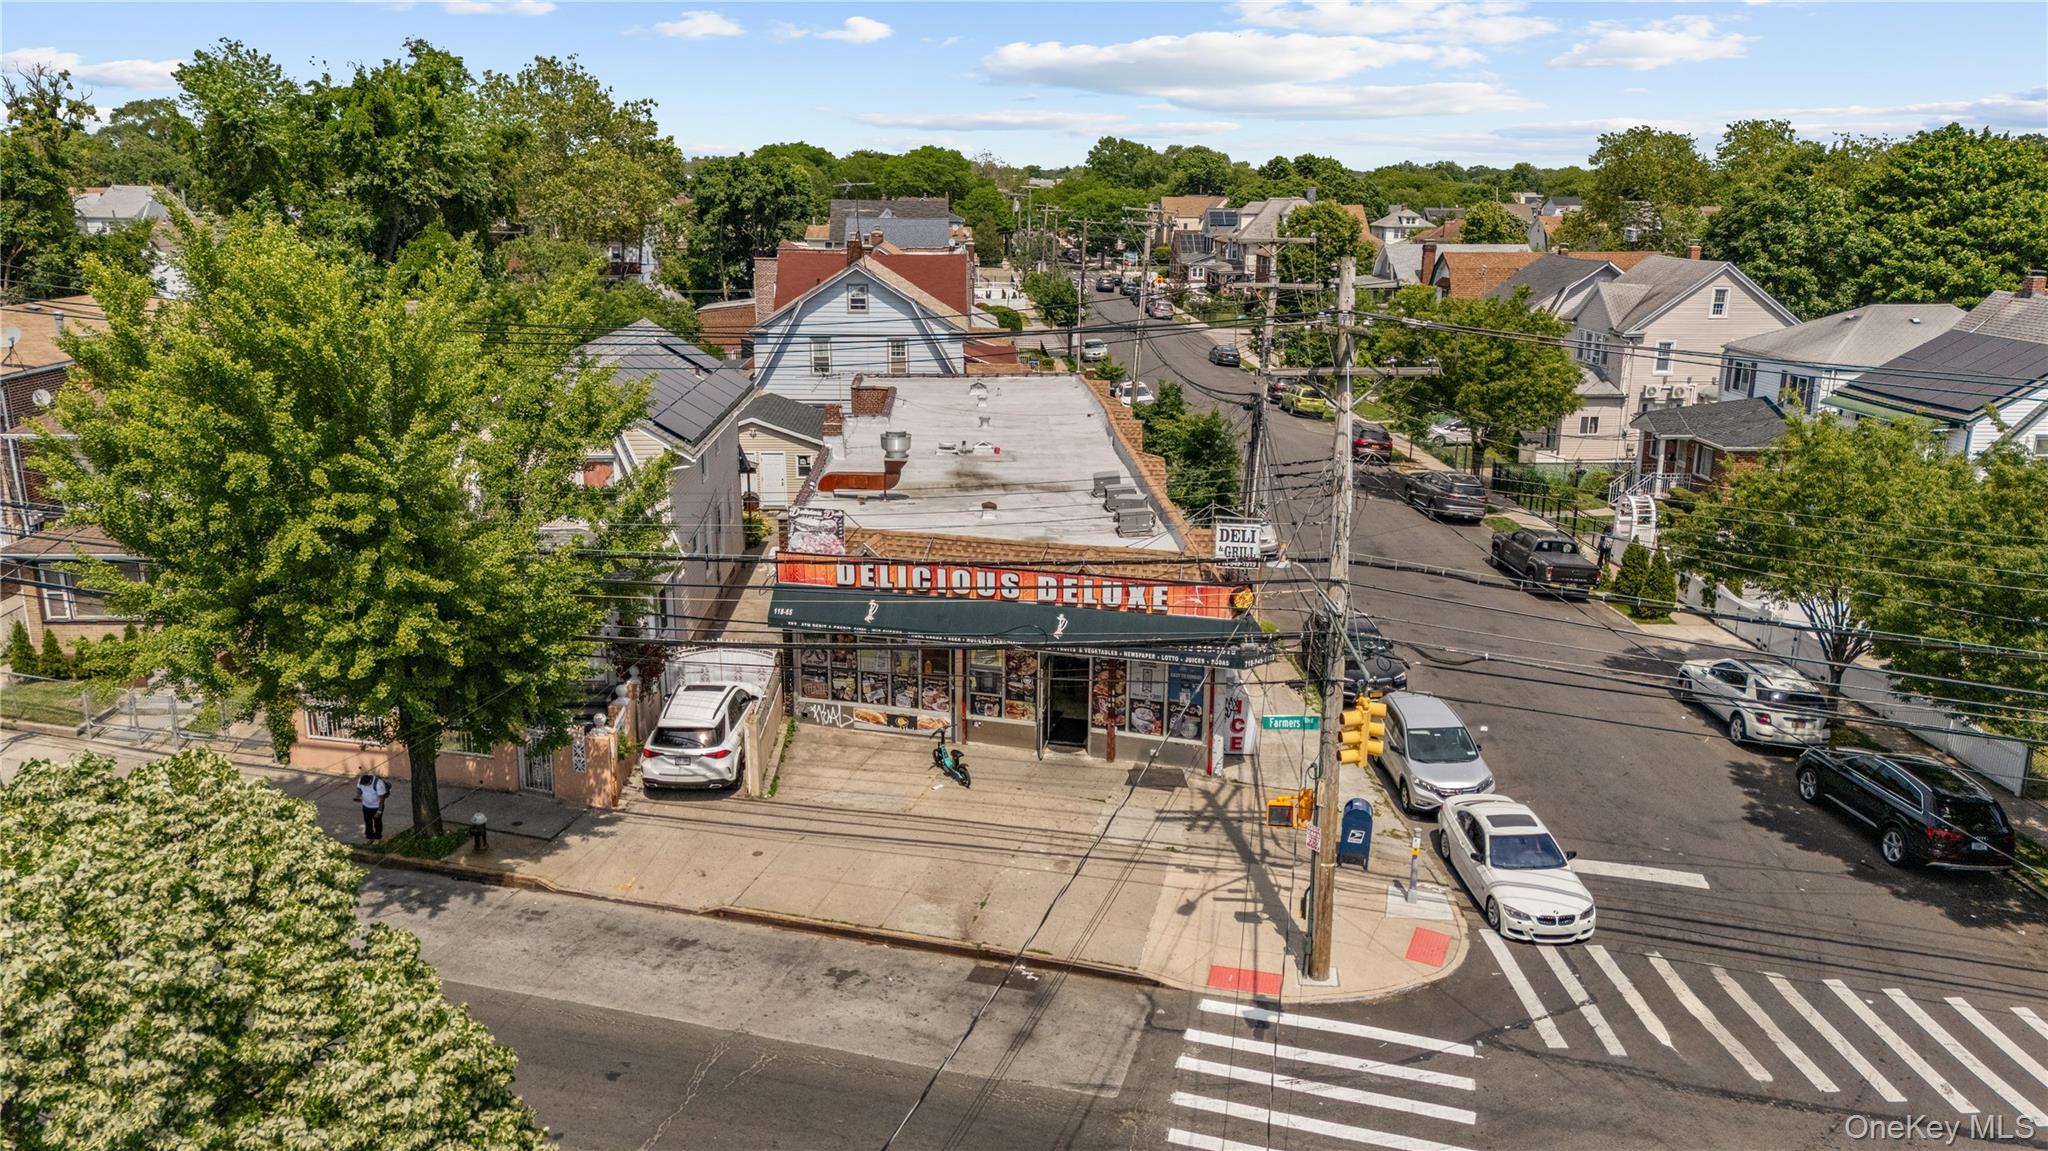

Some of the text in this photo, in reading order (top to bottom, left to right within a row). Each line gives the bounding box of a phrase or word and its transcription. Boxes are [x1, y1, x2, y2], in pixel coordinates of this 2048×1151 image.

[1219, 528, 1256, 543] DELI
[1224, 546, 1256, 558] GRILL
[836, 563, 1169, 611] DELICIOUS DELUXE
[1084, 647, 1118, 656] VEGETABLES
[1123, 650, 1155, 659] NEWSPAPER
[1230, 699, 1245, 751] ICE
[1269, 718, 1300, 728] Farmers
